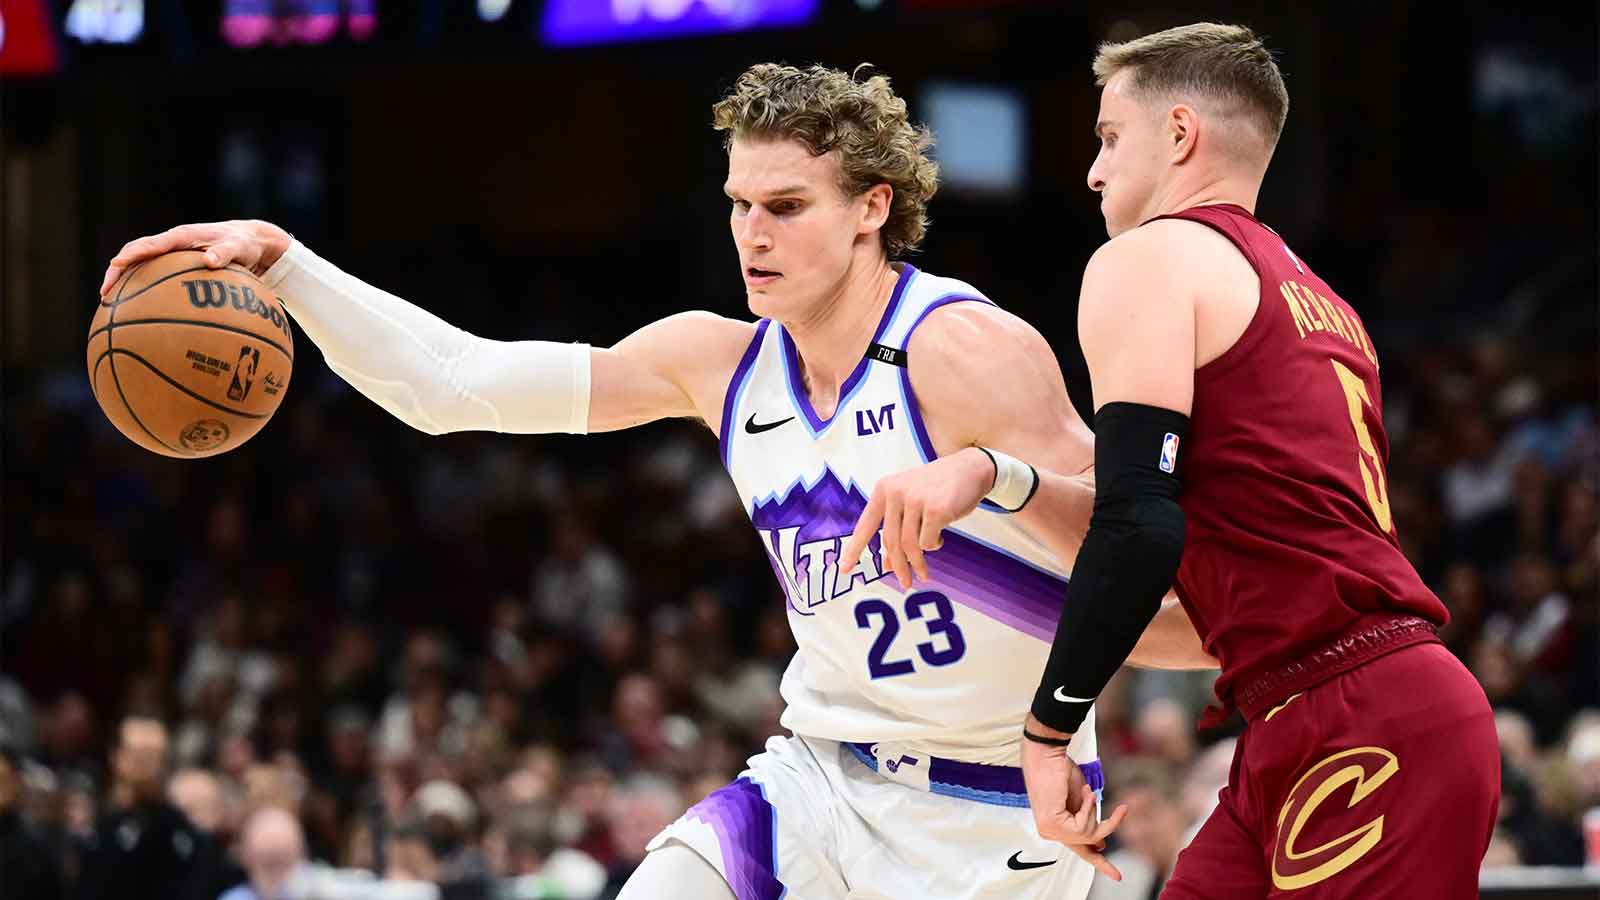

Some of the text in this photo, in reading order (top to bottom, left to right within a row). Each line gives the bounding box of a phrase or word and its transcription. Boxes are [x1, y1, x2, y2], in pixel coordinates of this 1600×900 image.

[1279, 280, 1380, 376] MERRIL
[855, 402, 896, 437] LVT
[1330, 358, 1393, 534] 5
[756, 525, 896, 616] UTA
[853, 589, 967, 681] 23
[1271, 746, 1400, 891] C
